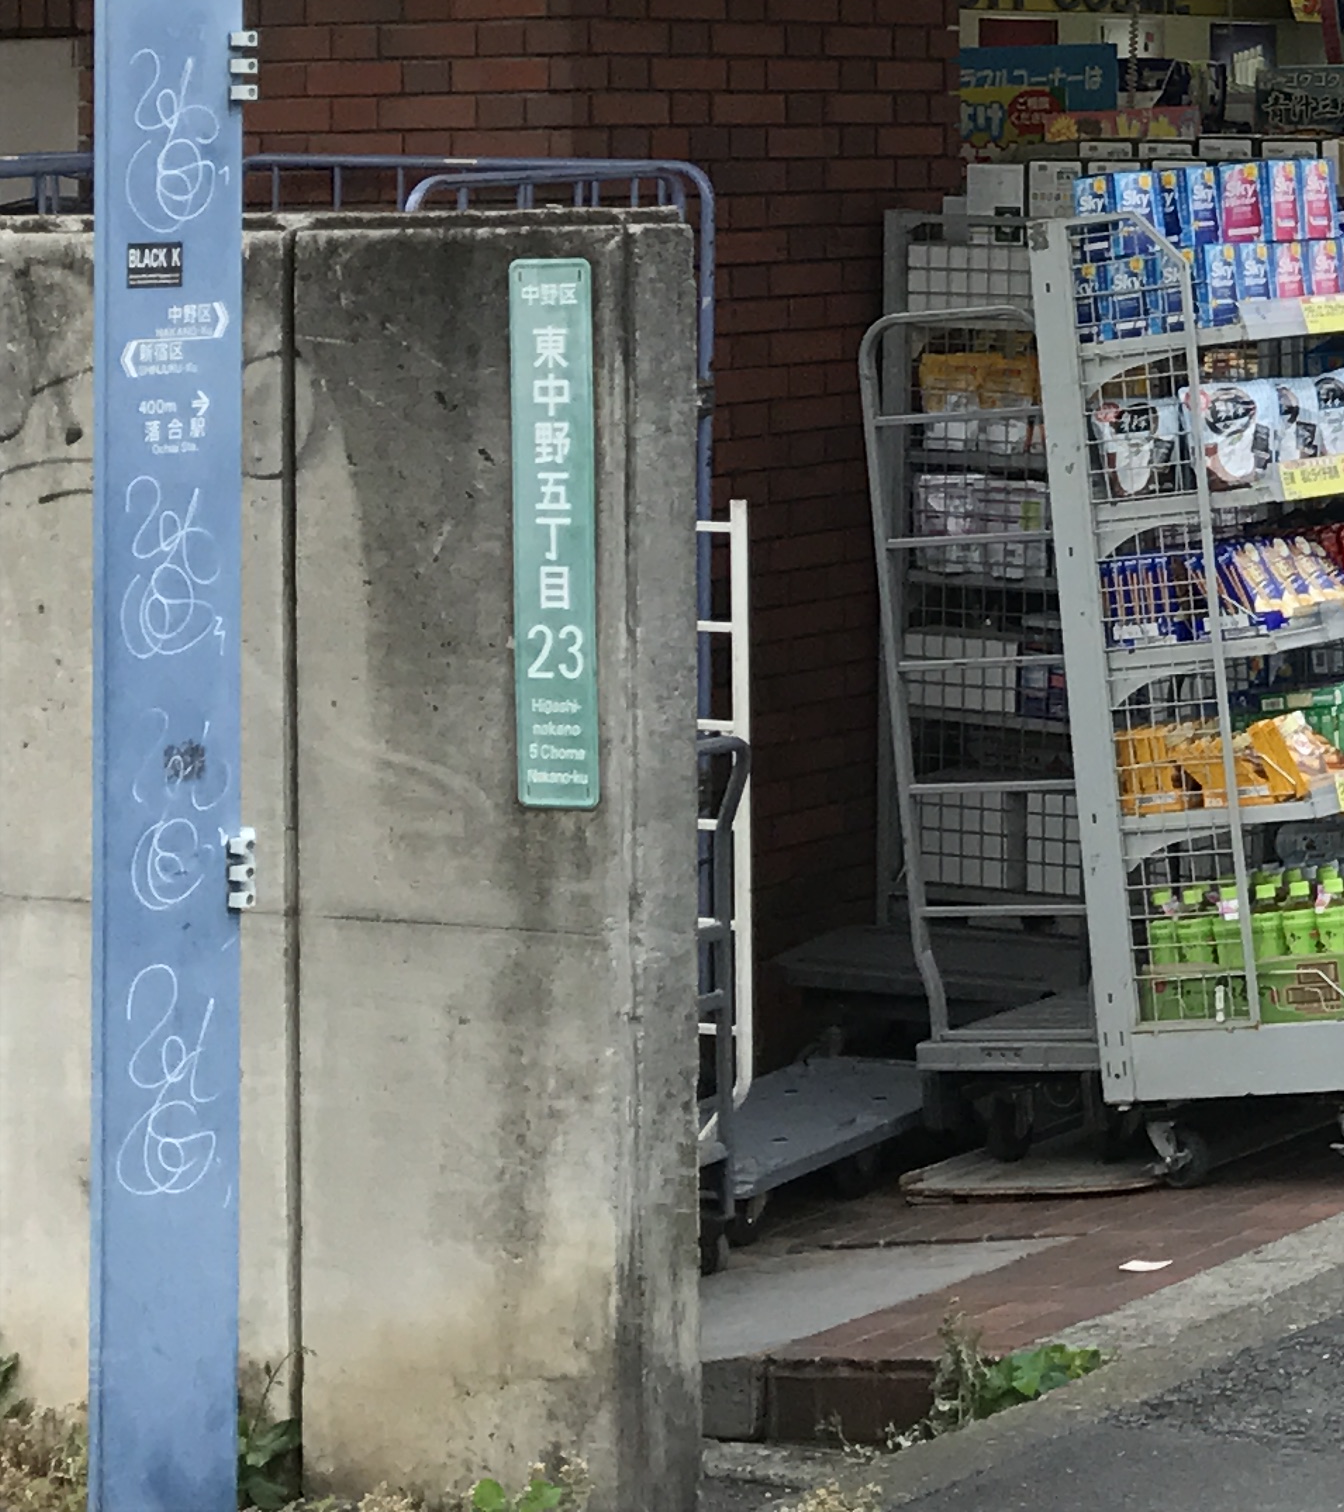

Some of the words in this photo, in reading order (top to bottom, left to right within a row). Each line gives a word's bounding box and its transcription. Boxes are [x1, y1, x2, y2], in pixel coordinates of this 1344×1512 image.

[129, 249, 167, 268] BLACK
[171, 247, 181, 266] K
[521, 281, 578, 306] 中野区
[168, 303, 212, 325] 中野区
[139, 342, 184, 362] 新宿区
[139, 399, 177, 415] 400m
[531, 325, 572, 611] 東中野五丁目
[527, 624, 584, 679] 23
[529, 743, 539, 759] 5
